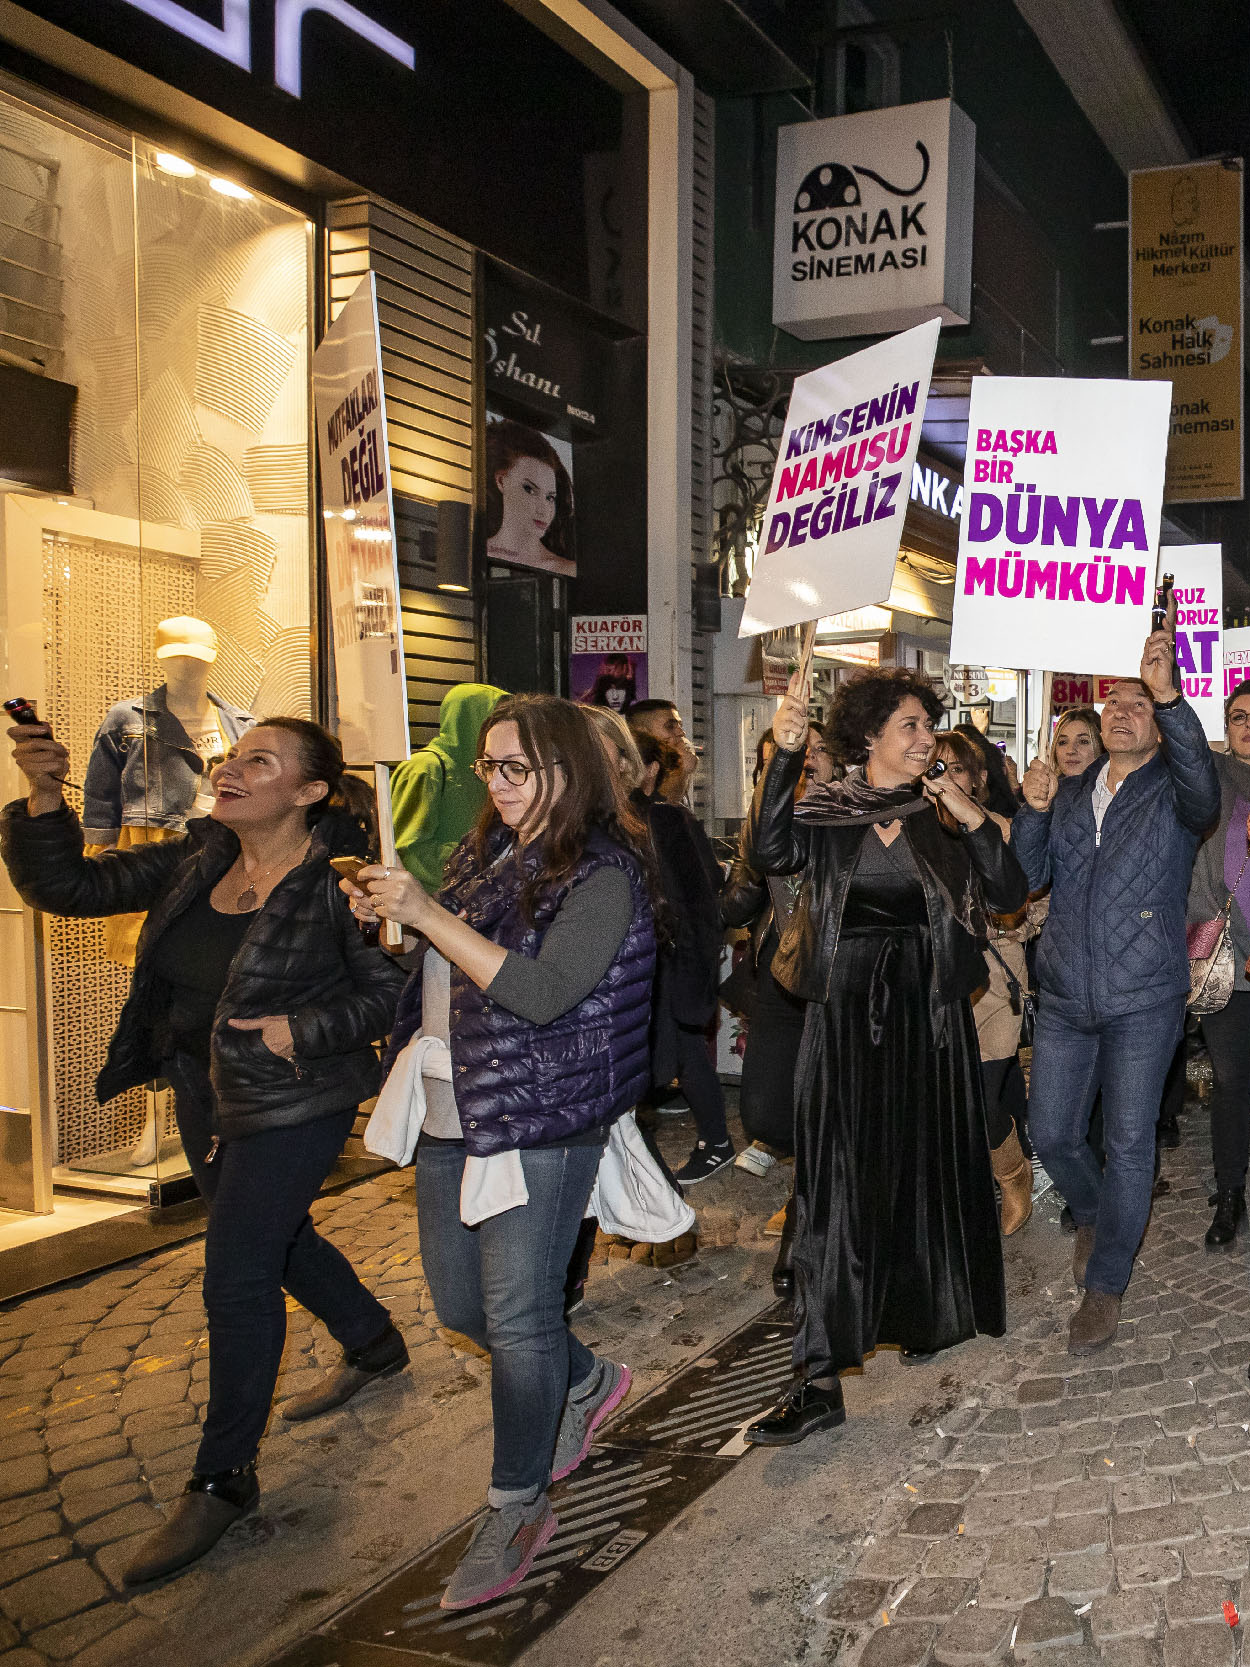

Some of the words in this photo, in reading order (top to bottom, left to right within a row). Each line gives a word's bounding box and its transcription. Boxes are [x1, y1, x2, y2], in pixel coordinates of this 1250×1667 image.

[791, 202, 927, 253] KONAK
[791, 245, 927, 282] SİNEMASI
[1136, 245, 1187, 261] Hikmet
[1189, 243, 1235, 259] Kültür
[1152, 261, 1211, 277] Merkezi
[1139, 313, 1197, 335] Konak
[1172, 331, 1213, 350] Halk
[1139, 351, 1211, 370] Sahnesi
[976, 429, 1058, 457] BAŞKA
[341, 425, 385, 505] DEĞİL
[776, 422, 912, 503] NAMUSU
[974, 455, 1014, 483] BİR
[764, 472, 902, 555] DEĞİLİZ
[968, 483, 1149, 551] DÜNYA
[964, 551, 1146, 605] MÜMKÜN
[576, 617, 643, 633] KUAFÖR
[575, 636, 644, 652] SERKAN
[968, 684, 979, 696] 3
